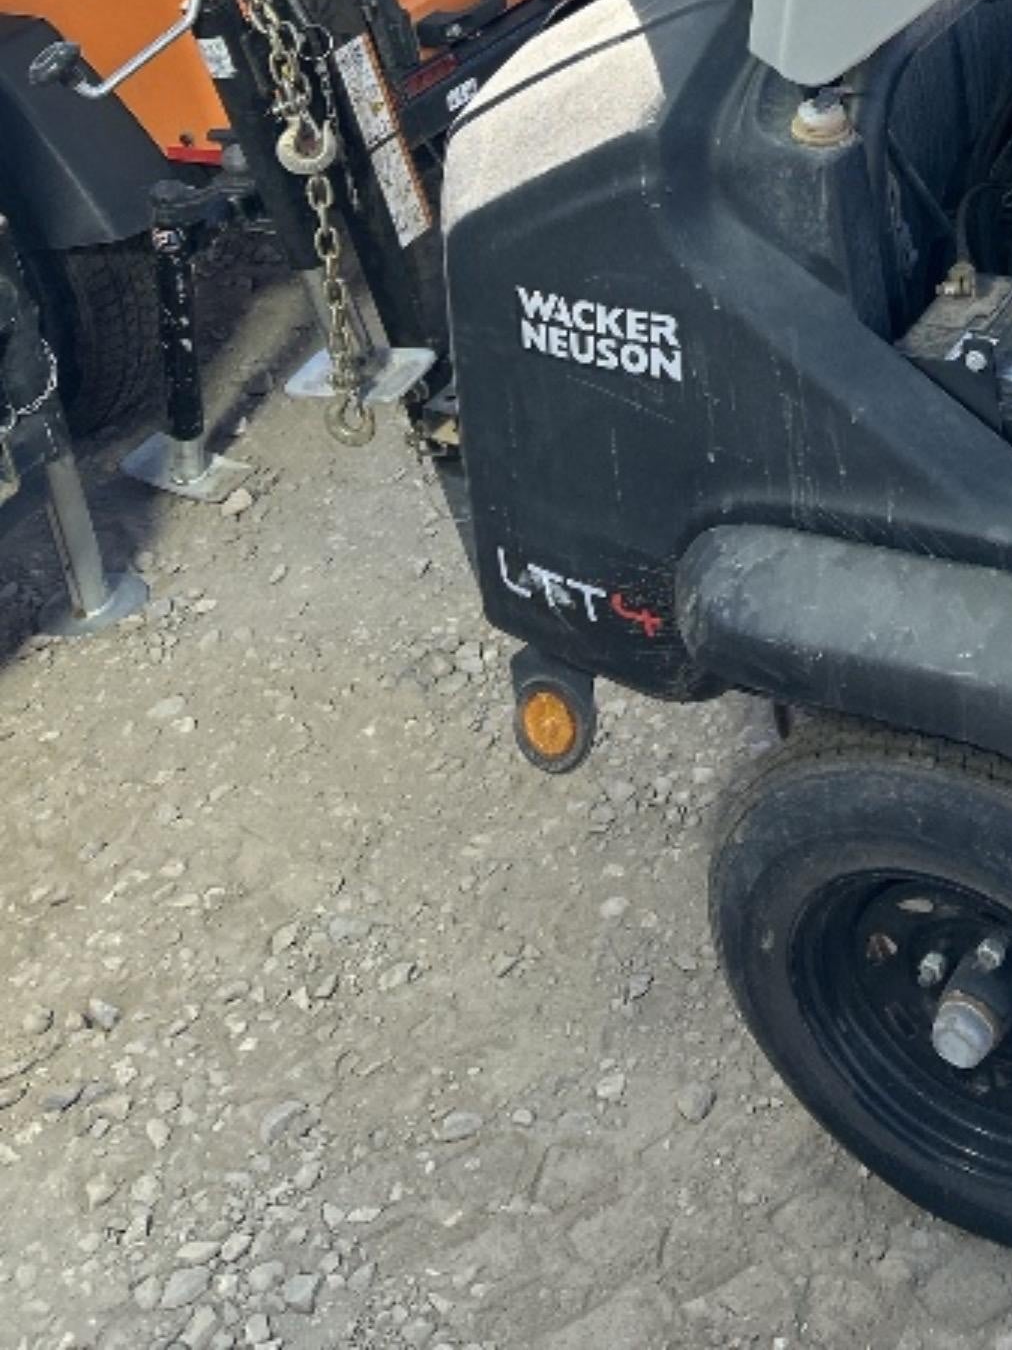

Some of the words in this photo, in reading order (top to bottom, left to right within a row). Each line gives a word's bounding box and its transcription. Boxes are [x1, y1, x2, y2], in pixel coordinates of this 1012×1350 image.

[515, 284, 682, 349] WACKER
[521, 317, 682, 382] NEUSON
[497, 545, 663, 638] LTT4
